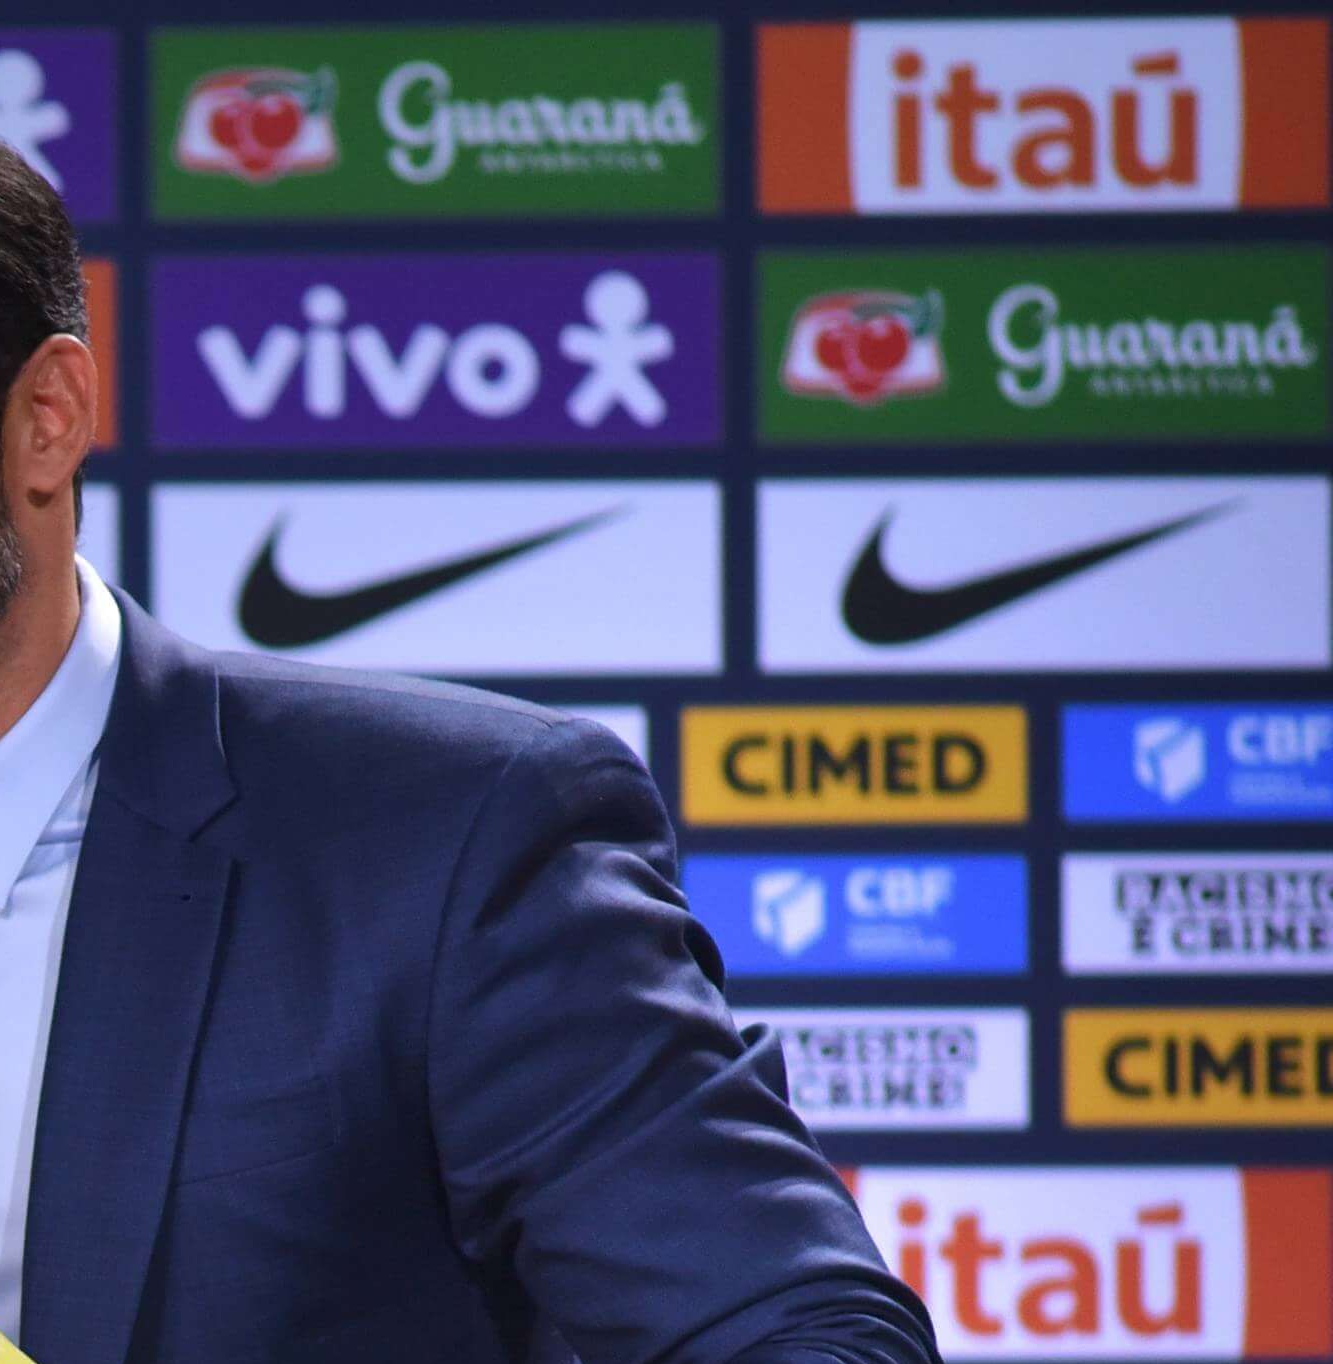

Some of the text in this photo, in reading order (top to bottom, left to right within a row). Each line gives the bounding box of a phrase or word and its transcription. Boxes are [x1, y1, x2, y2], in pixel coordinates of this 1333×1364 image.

[377, 60, 702, 184] Guaraná
[892, 51, 1199, 191] itaú
[198, 285, 540, 418] vivo
[986, 283, 1313, 407] Guaraná
[720, 731, 989, 797] CIMED
[897, 1199, 1204, 1336] itaú
